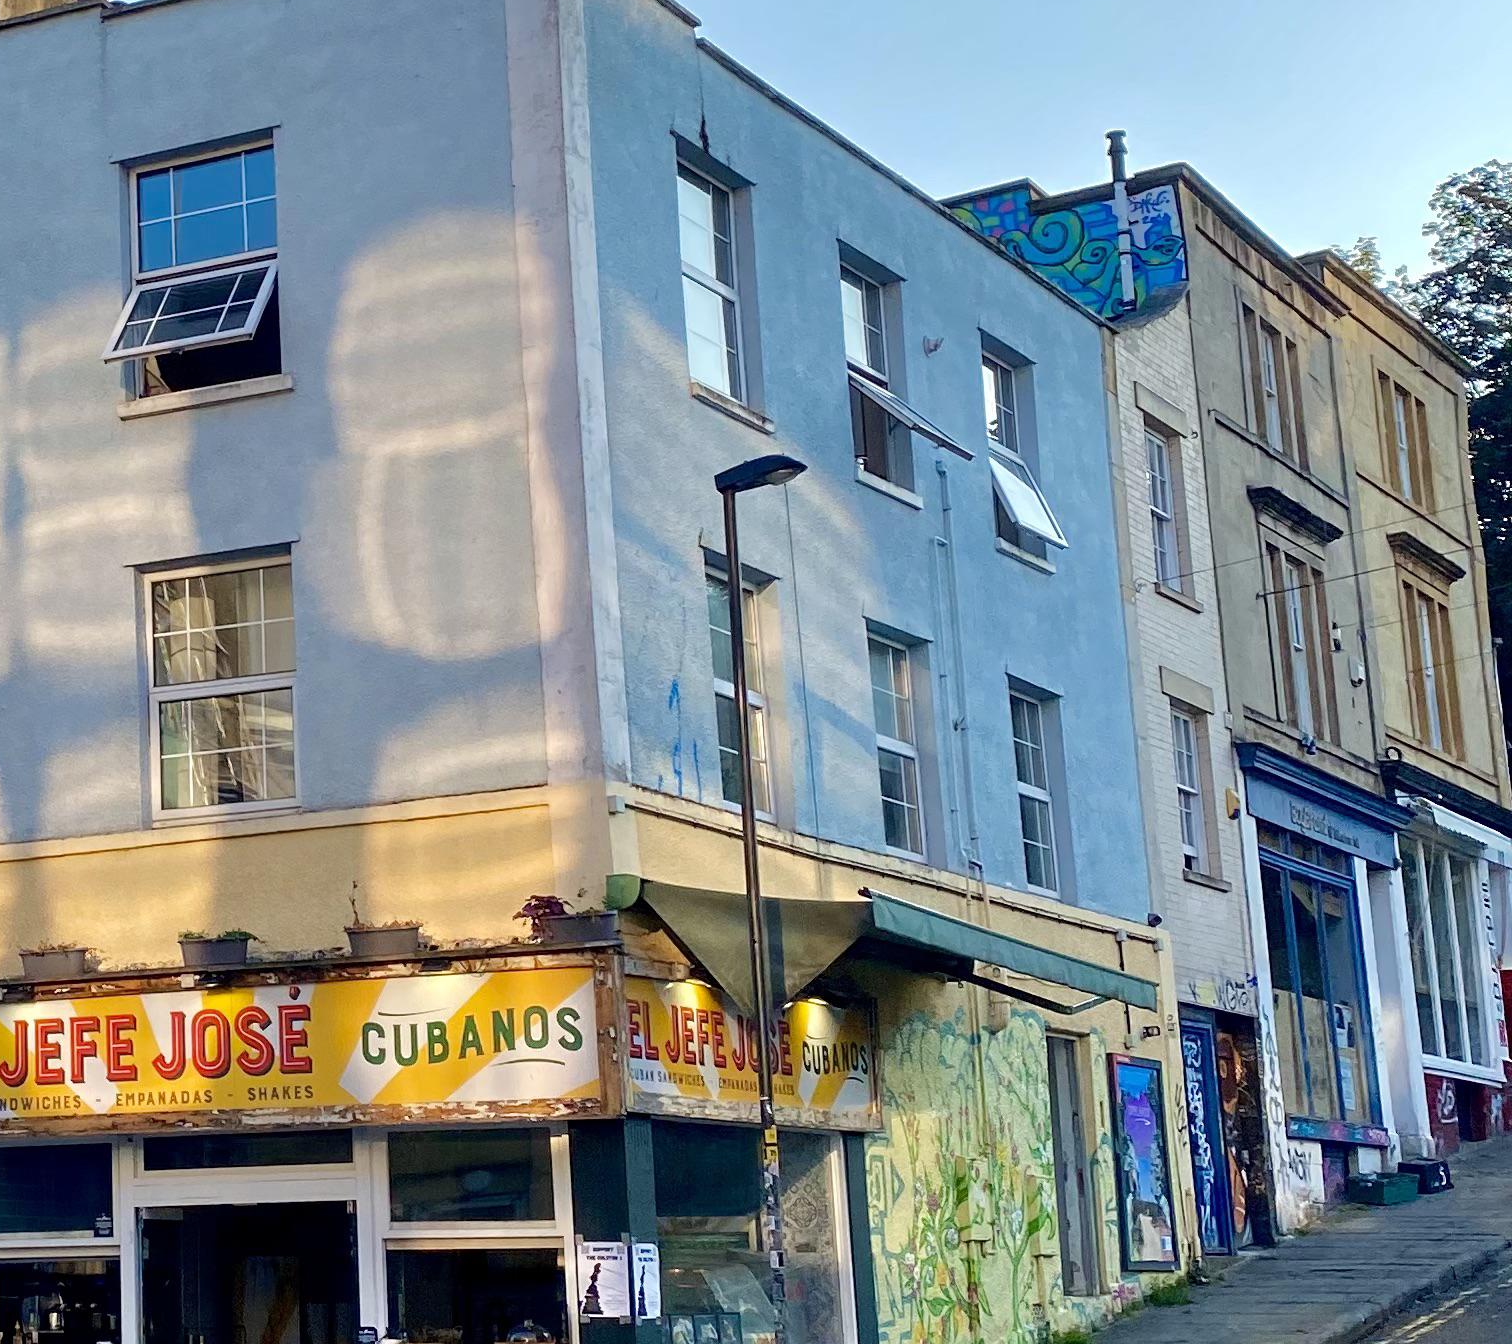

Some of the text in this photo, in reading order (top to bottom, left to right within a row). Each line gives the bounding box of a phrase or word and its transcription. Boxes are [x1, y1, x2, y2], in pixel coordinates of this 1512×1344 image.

[151, 985, 313, 1080] JOSÉ
[361, 1005, 583, 1066] CUBANOS
[626, 999, 659, 1061] EL
[665, 1005, 726, 1069] JEFE
[630, 1068, 654, 1081] CUBAN
[657, 1071, 705, 1087] SANDWICHES
[802, 1041, 868, 1075] CUBANOS
[116, 1089, 213, 1107] EMPANADAS
[247, 1085, 314, 1102] SHAKES
